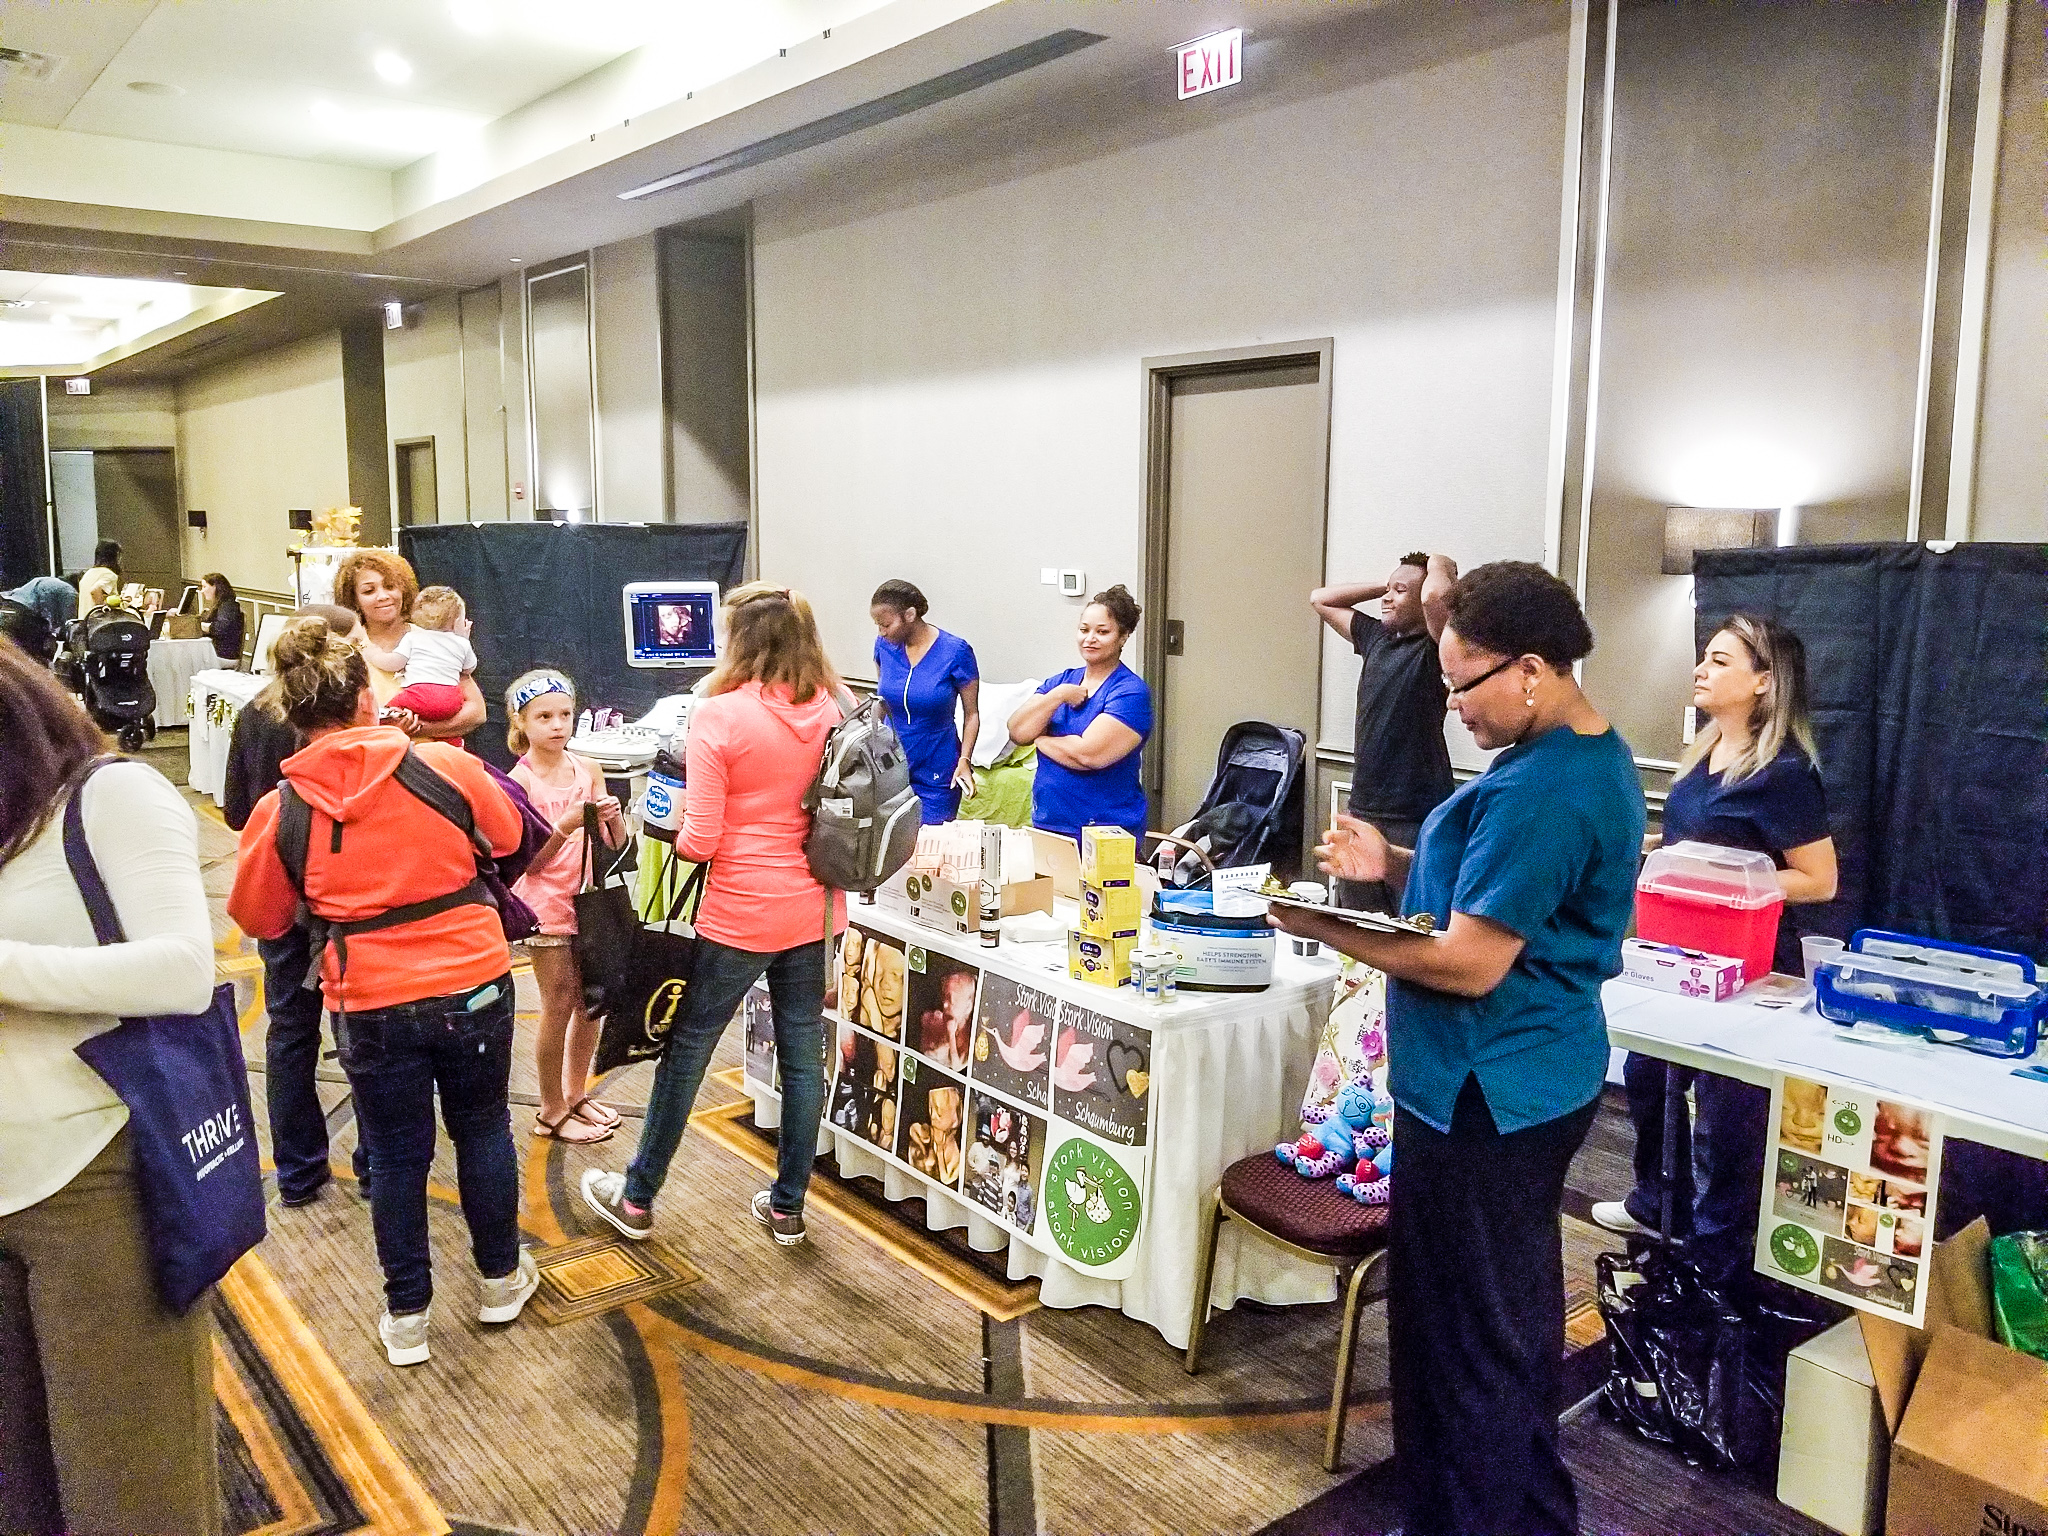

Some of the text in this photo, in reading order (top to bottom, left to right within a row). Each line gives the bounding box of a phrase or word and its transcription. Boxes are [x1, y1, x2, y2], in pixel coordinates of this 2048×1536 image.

[1183, 37, 1238, 94] EXIT
[1630, 971, 1655, 982] Gloves
[181, 1103, 241, 1164] THRIVE
[1074, 1101, 1135, 1147] Schaumburg
[1051, 1142, 1133, 1210] stork vision
[1048, 1200, 1130, 1260] stork vision
